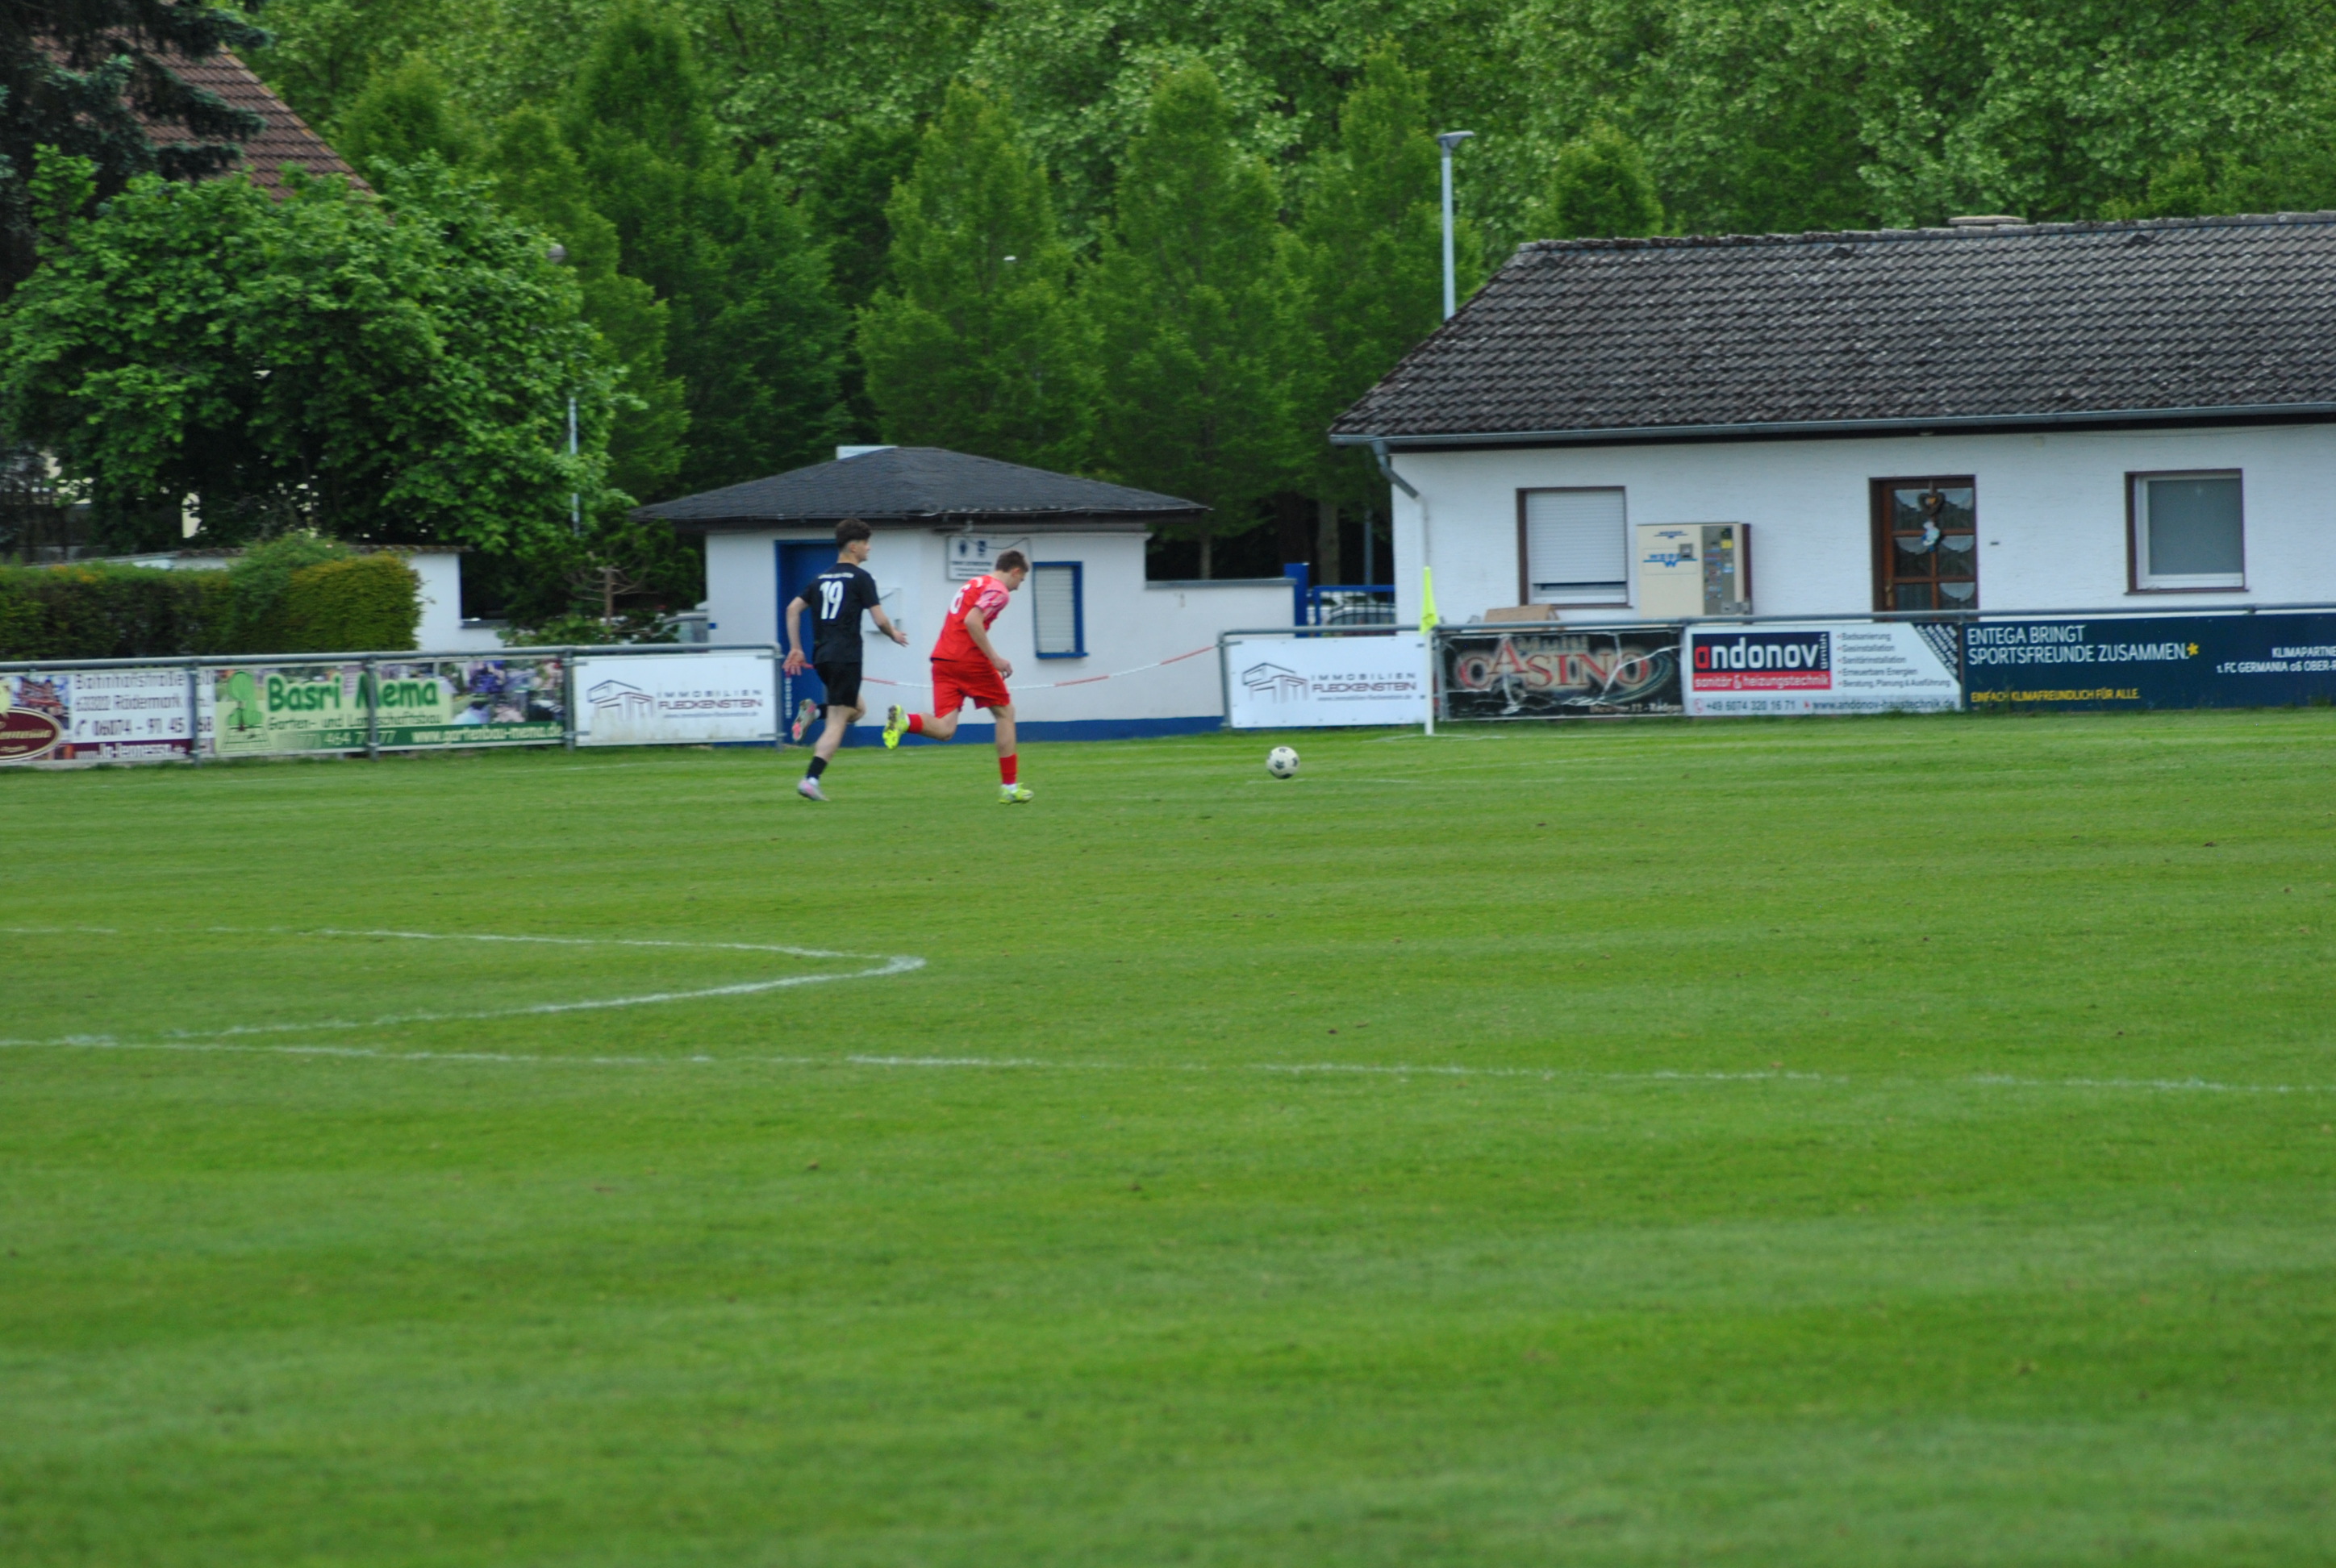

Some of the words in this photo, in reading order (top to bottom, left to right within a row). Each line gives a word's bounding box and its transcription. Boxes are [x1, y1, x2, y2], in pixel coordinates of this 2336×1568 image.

[820, 581, 844, 619] 19
[1967, 627, 2027, 645] ENTEGA
[2029, 624, 2087, 644] BRINGT
[1695, 636, 1820, 669] andonov
[1819, 632, 1829, 669] gmbh
[1967, 644, 2096, 665] SPORTSFREUNDE
[1458, 636, 1650, 689] CASINO
[2224, 661, 2237, 673] FC
[2238, 661, 2289, 673] GERMANIA
[1311, 672, 1416, 681] IMMOBILIEN
[1695, 676, 1733, 687] sanitär
[1743, 674, 1829, 690] heizungstechnik
[267, 674, 340, 712] Basri
[657, 689, 763, 698] IMMOBILIEN
[1312, 682, 1417, 693] FLECKENSTEIN
[2011, 689, 2095, 702] KLIMAFREUNDLICH
[2096, 686, 2113, 700] FÜR
[113, 693, 184, 711] Rödermark
[657, 699, 764, 710] FLECKENSTEIN
[1706, 701, 1723, 711] +49
[1784, 700, 1796, 710] 71
[92, 719, 132, 736] 06074
[169, 716, 186, 733] 45
[269, 716, 317, 731] Garten-
[322, 713, 343, 728] und
[346, 711, 441, 728] Lanschaftsbau
[325, 732, 351, 746] 464
[378, 730, 396, 744] 77
[411, 723, 563, 745] www.gartenbau-mema.de
